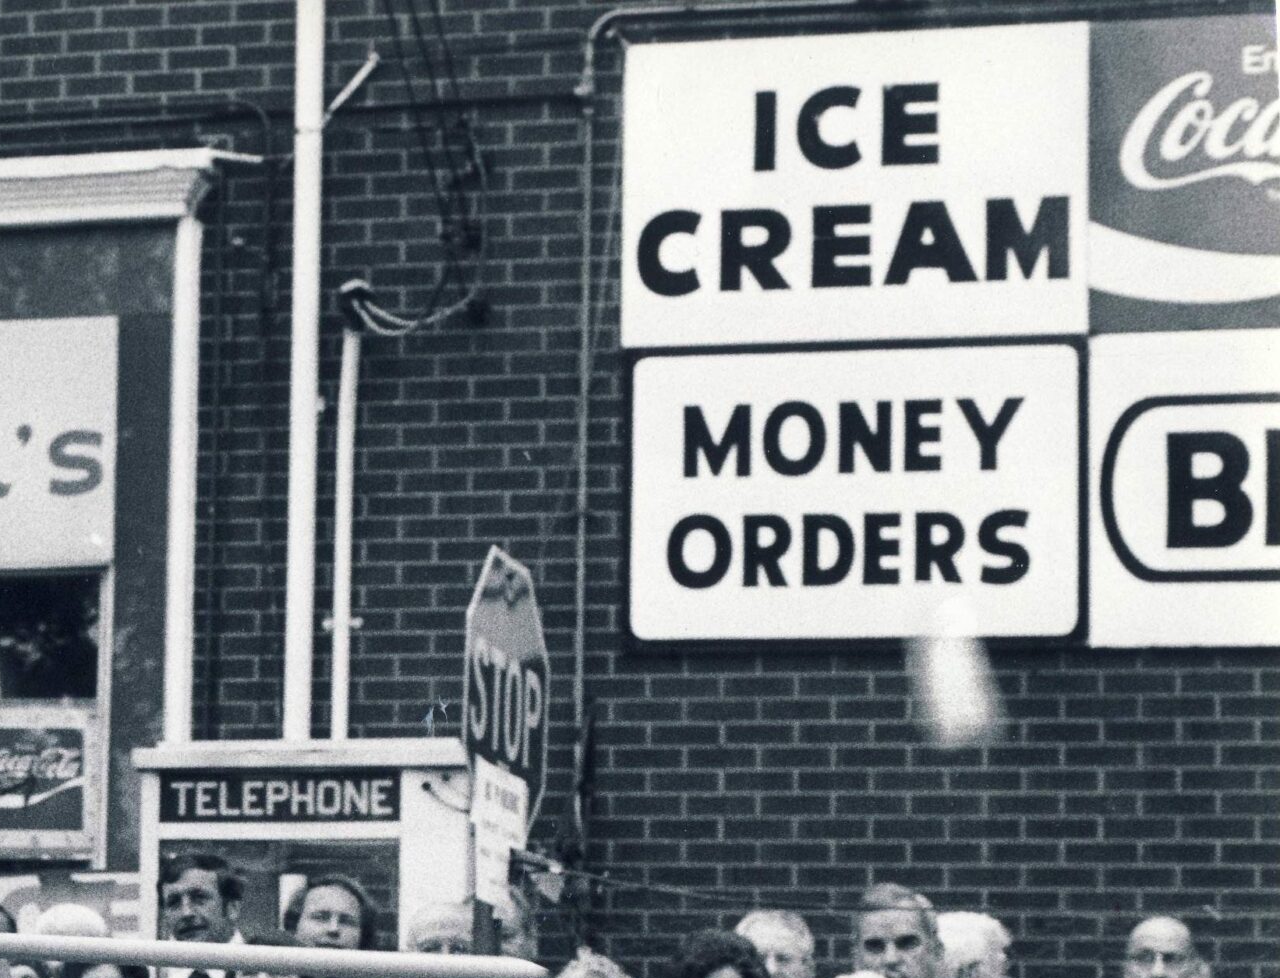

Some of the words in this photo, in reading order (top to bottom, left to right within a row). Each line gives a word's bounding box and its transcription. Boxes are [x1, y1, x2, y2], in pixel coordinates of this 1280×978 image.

[753, 83, 940, 171] ICE
[637, 195, 1070, 298] CREAM
[683, 398, 1024, 479] MONEY
[1166, 429, 1280, 548] B
[666, 509, 1031, 589] ORDERS
[470, 637, 542, 769] STOP
[171, 779, 394, 817] TELEPHONE
